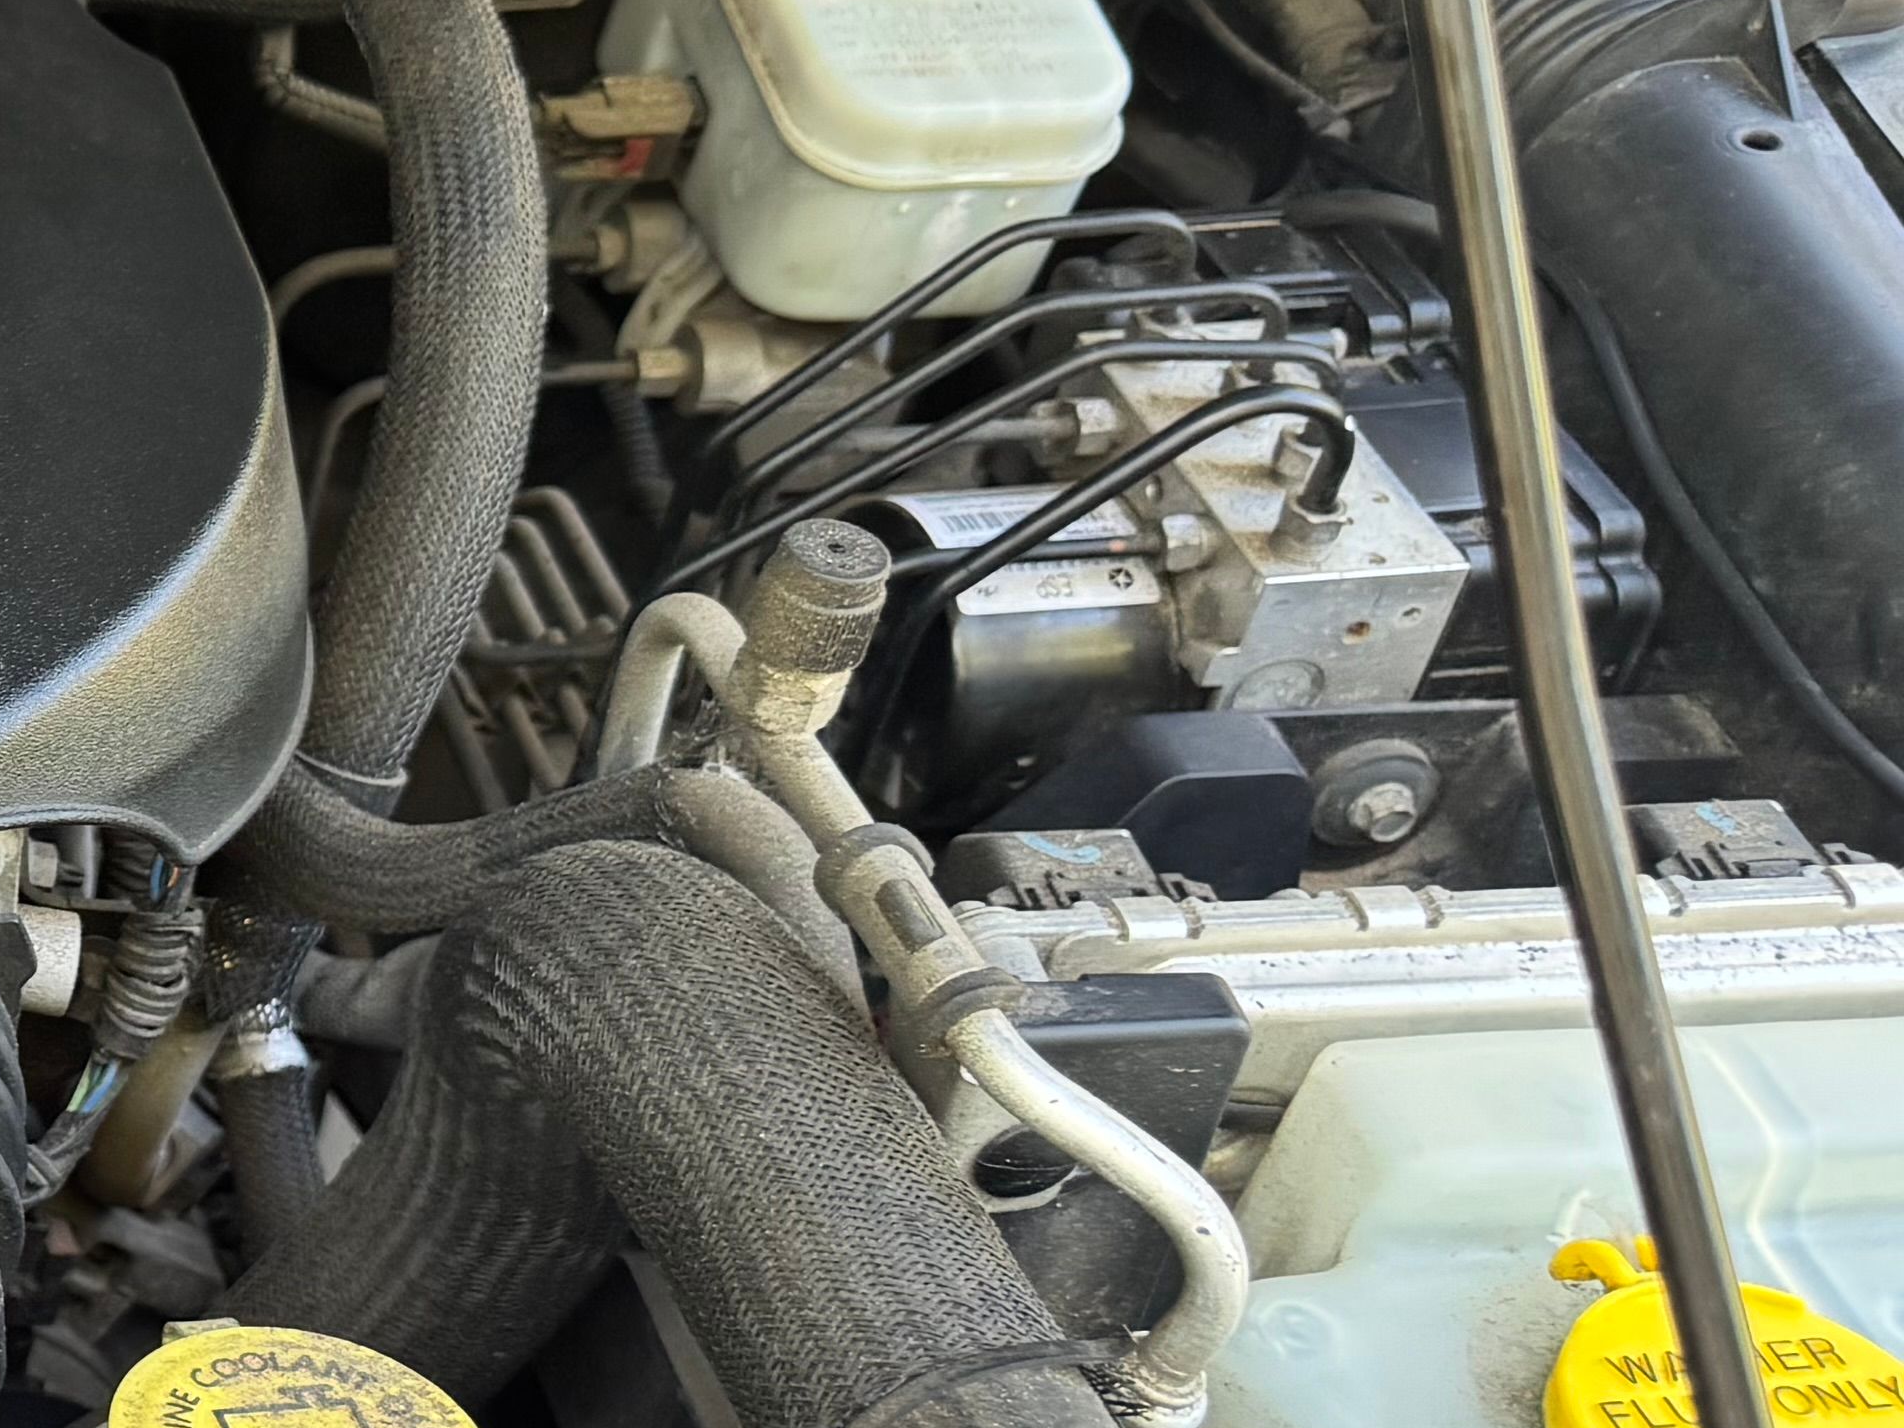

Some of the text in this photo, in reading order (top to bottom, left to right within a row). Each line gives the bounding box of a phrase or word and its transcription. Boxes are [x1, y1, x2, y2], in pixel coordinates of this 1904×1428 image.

[192, 1352, 379, 1390] COOLANT
[1601, 1337, 1847, 1384] WAER
[1773, 1375, 1904, 1415] ONLY
